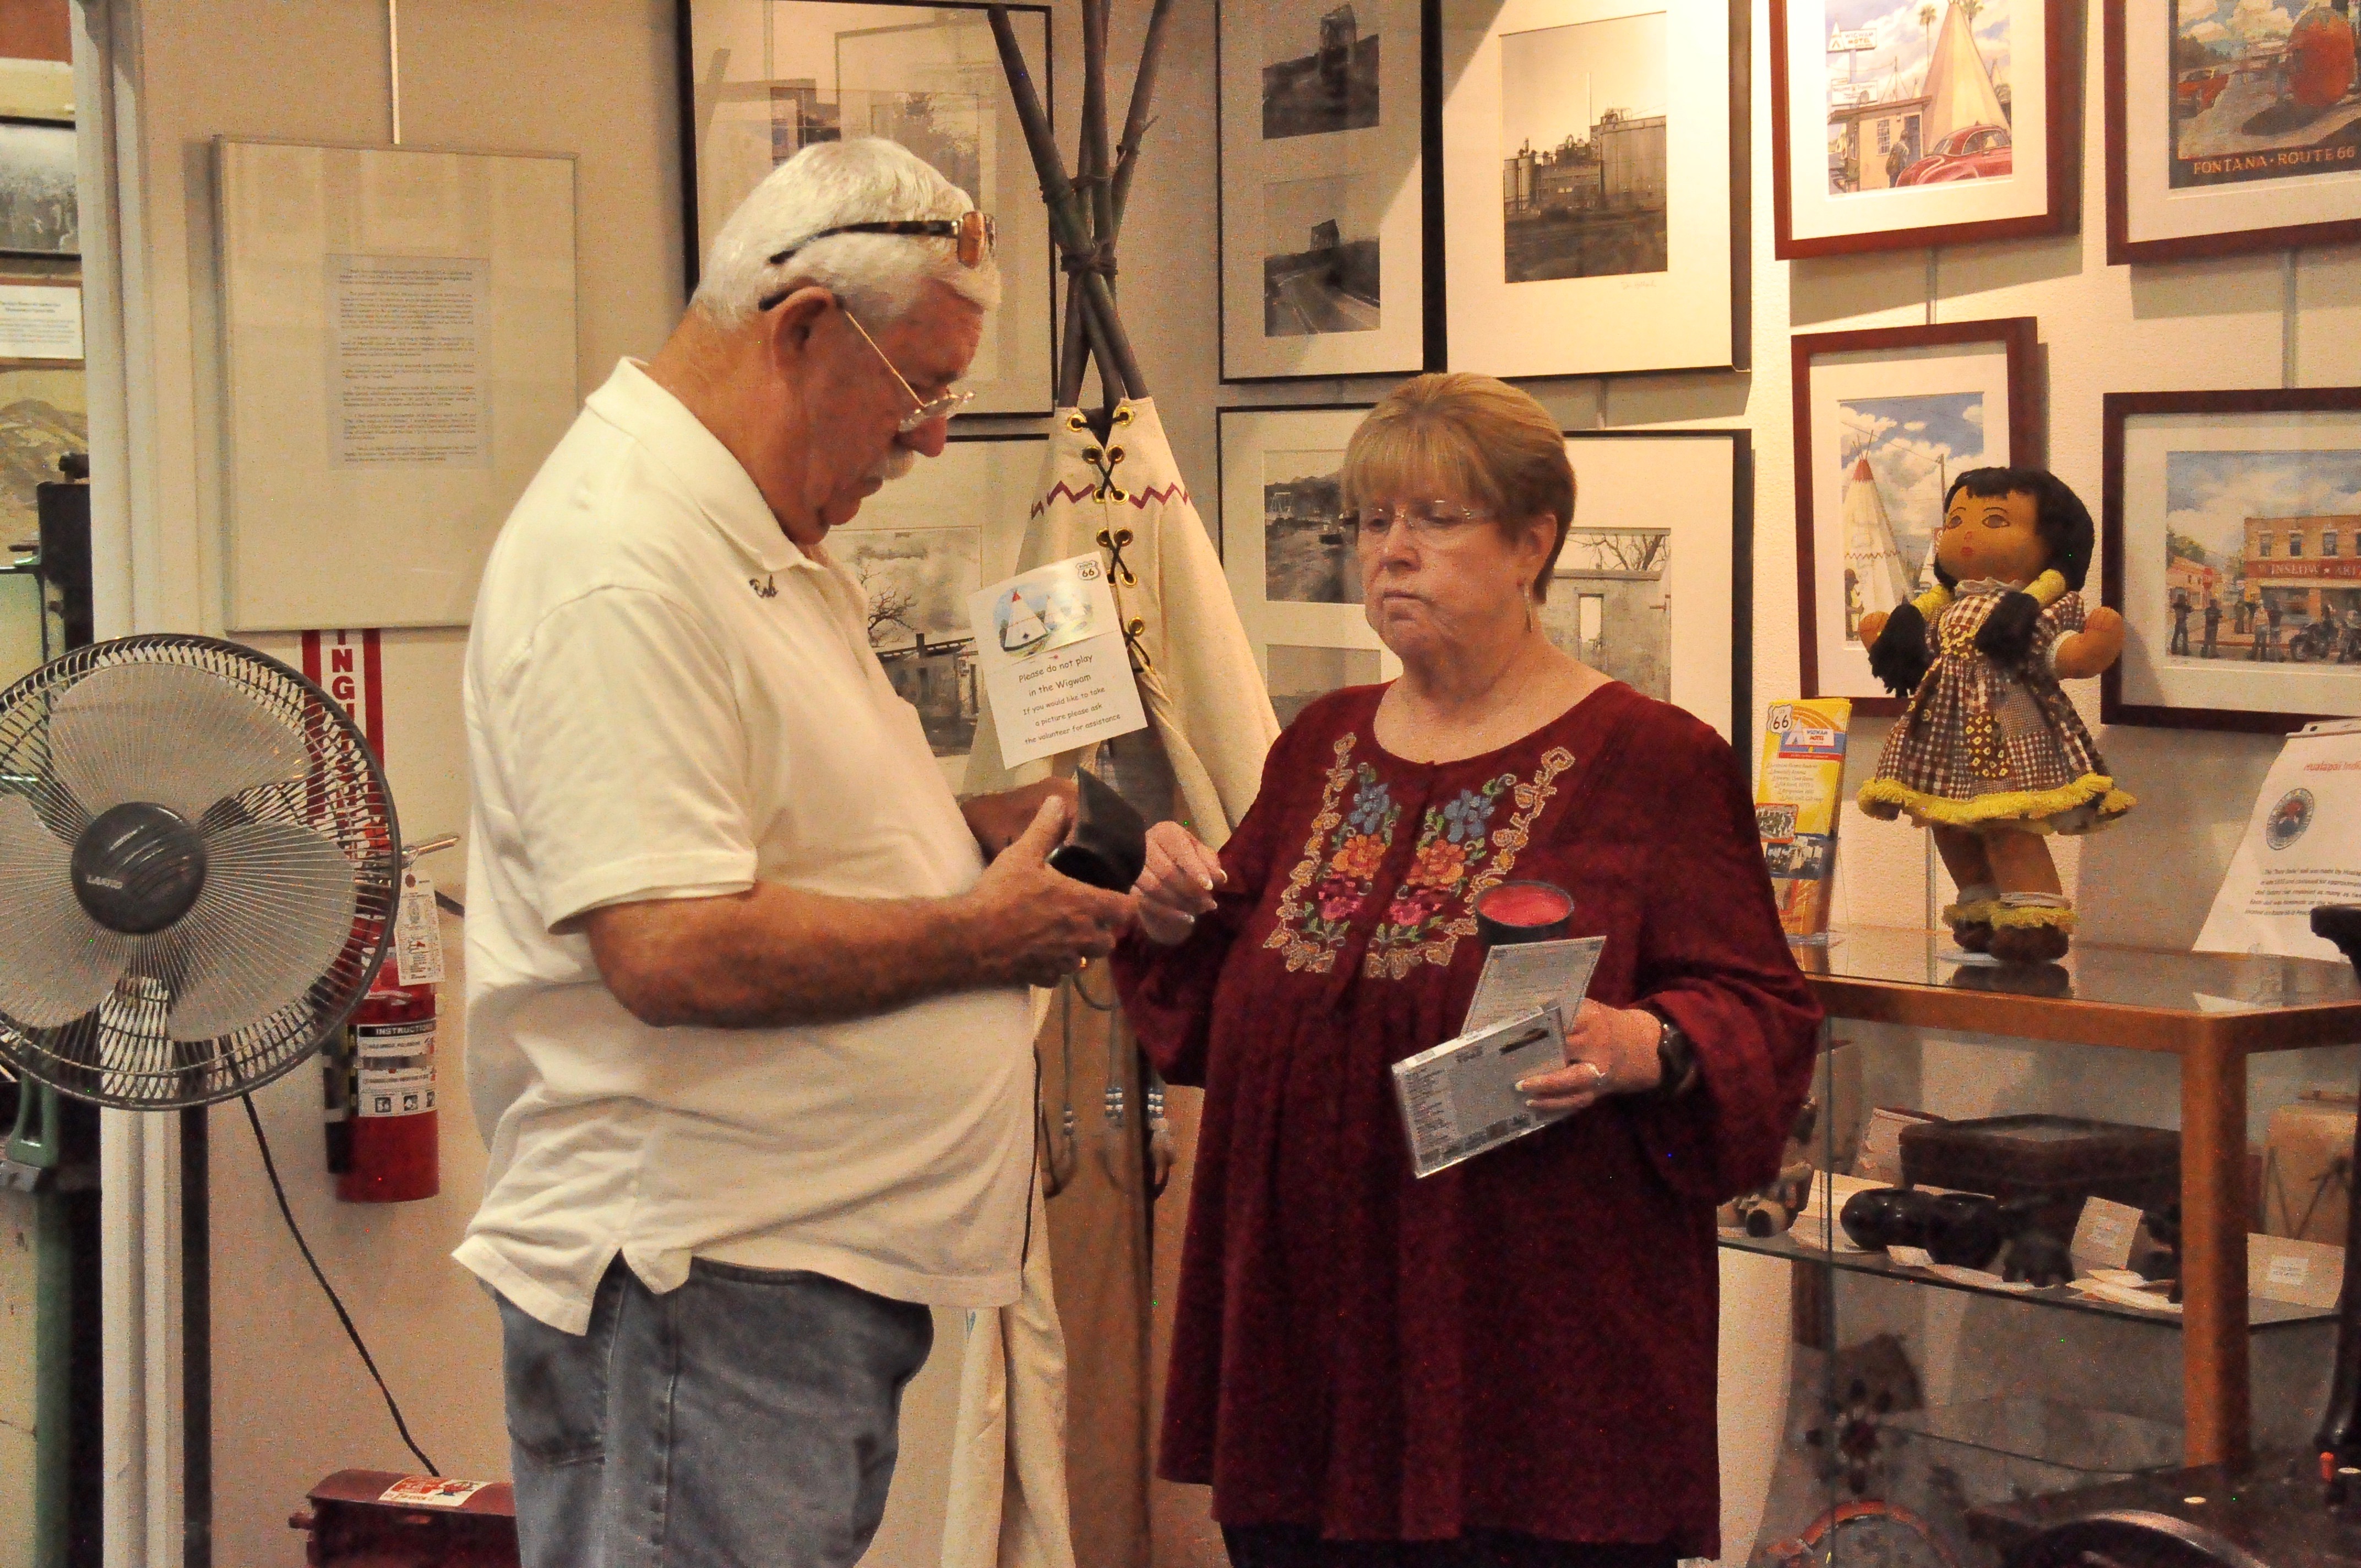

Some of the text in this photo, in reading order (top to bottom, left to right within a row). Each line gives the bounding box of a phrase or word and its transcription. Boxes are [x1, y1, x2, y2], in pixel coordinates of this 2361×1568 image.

[2193, 146, 2355, 175] FONTANA ROUTE 66
[1082, 568, 1095, 578] 66
[1019, 655, 1092, 683] Please do not play
[1038, 684, 1053, 694] the
[1056, 674, 1091, 689] Wigwam
[1032, 704, 1044, 714] you
[1046, 698, 1065, 707] would
[1067, 694, 1079, 703] like
[1090, 687, 1105, 696] take
[1041, 714, 1066, 726] picture
[1068, 707, 1089, 719] please
[1091, 703, 1103, 712] ask
[1773, 714, 1789, 730] 66
[1025, 714, 1121, 745] the volunteer for assistance
